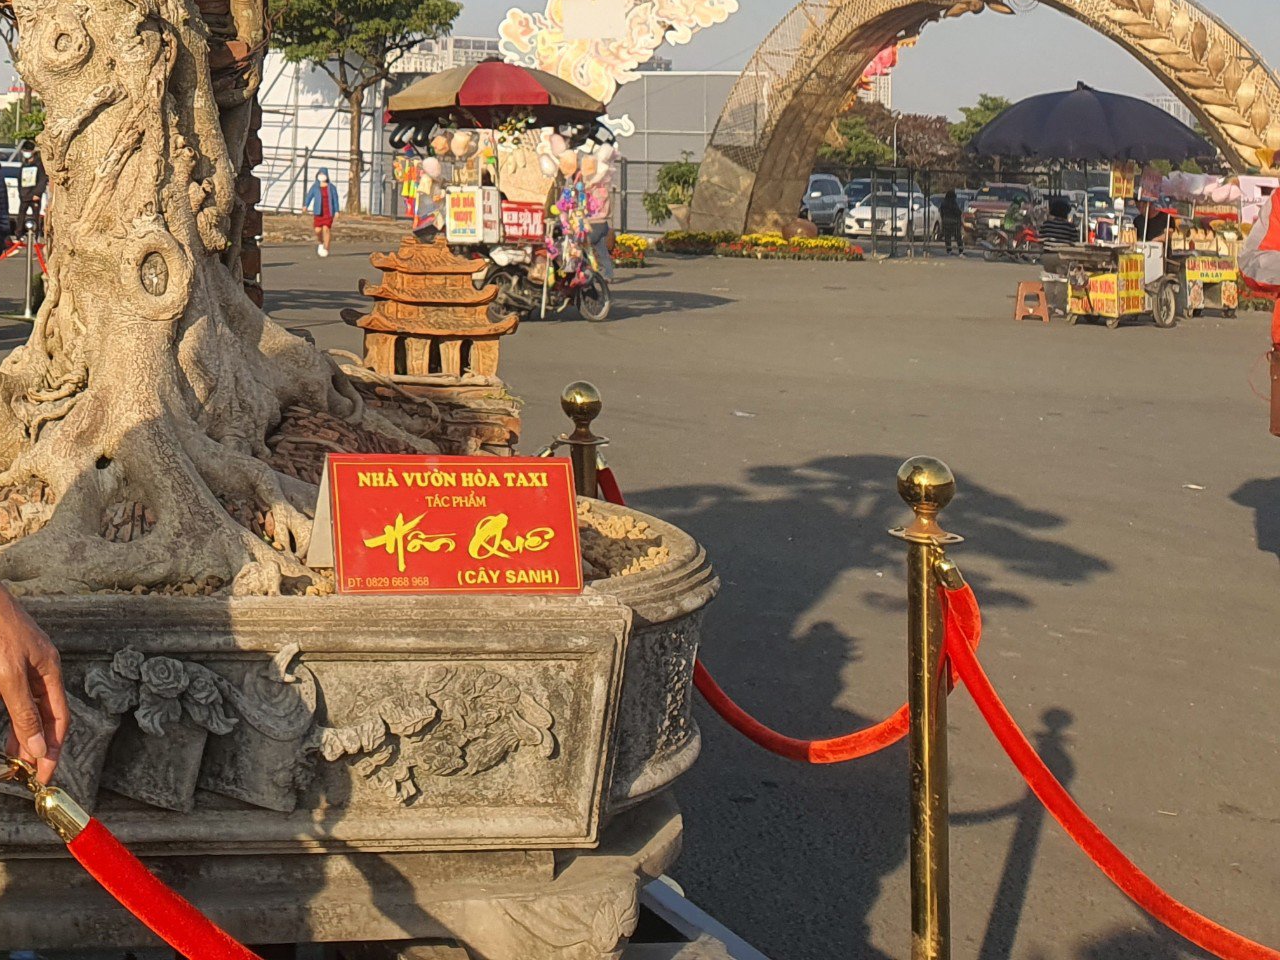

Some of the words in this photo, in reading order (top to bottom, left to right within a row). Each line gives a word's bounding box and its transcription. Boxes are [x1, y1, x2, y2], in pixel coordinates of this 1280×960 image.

[357, 467, 400, 487] NHÀ
[401, 467, 457, 487] VƯỜN
[460, 468, 501, 487] HÒA
[503, 471, 549, 487] TAXI
[424, 493, 451, 508] TÁC
[451, 489, 487, 508] PHẨM
[468, 512, 556, 561] Quê
[365, 576, 390, 587] 0829
[391, 576, 410, 587] 668
[411, 576, 430, 587] 968
[457, 566, 501, 586] (CÂY
[504, 568, 561, 585] SANH)
